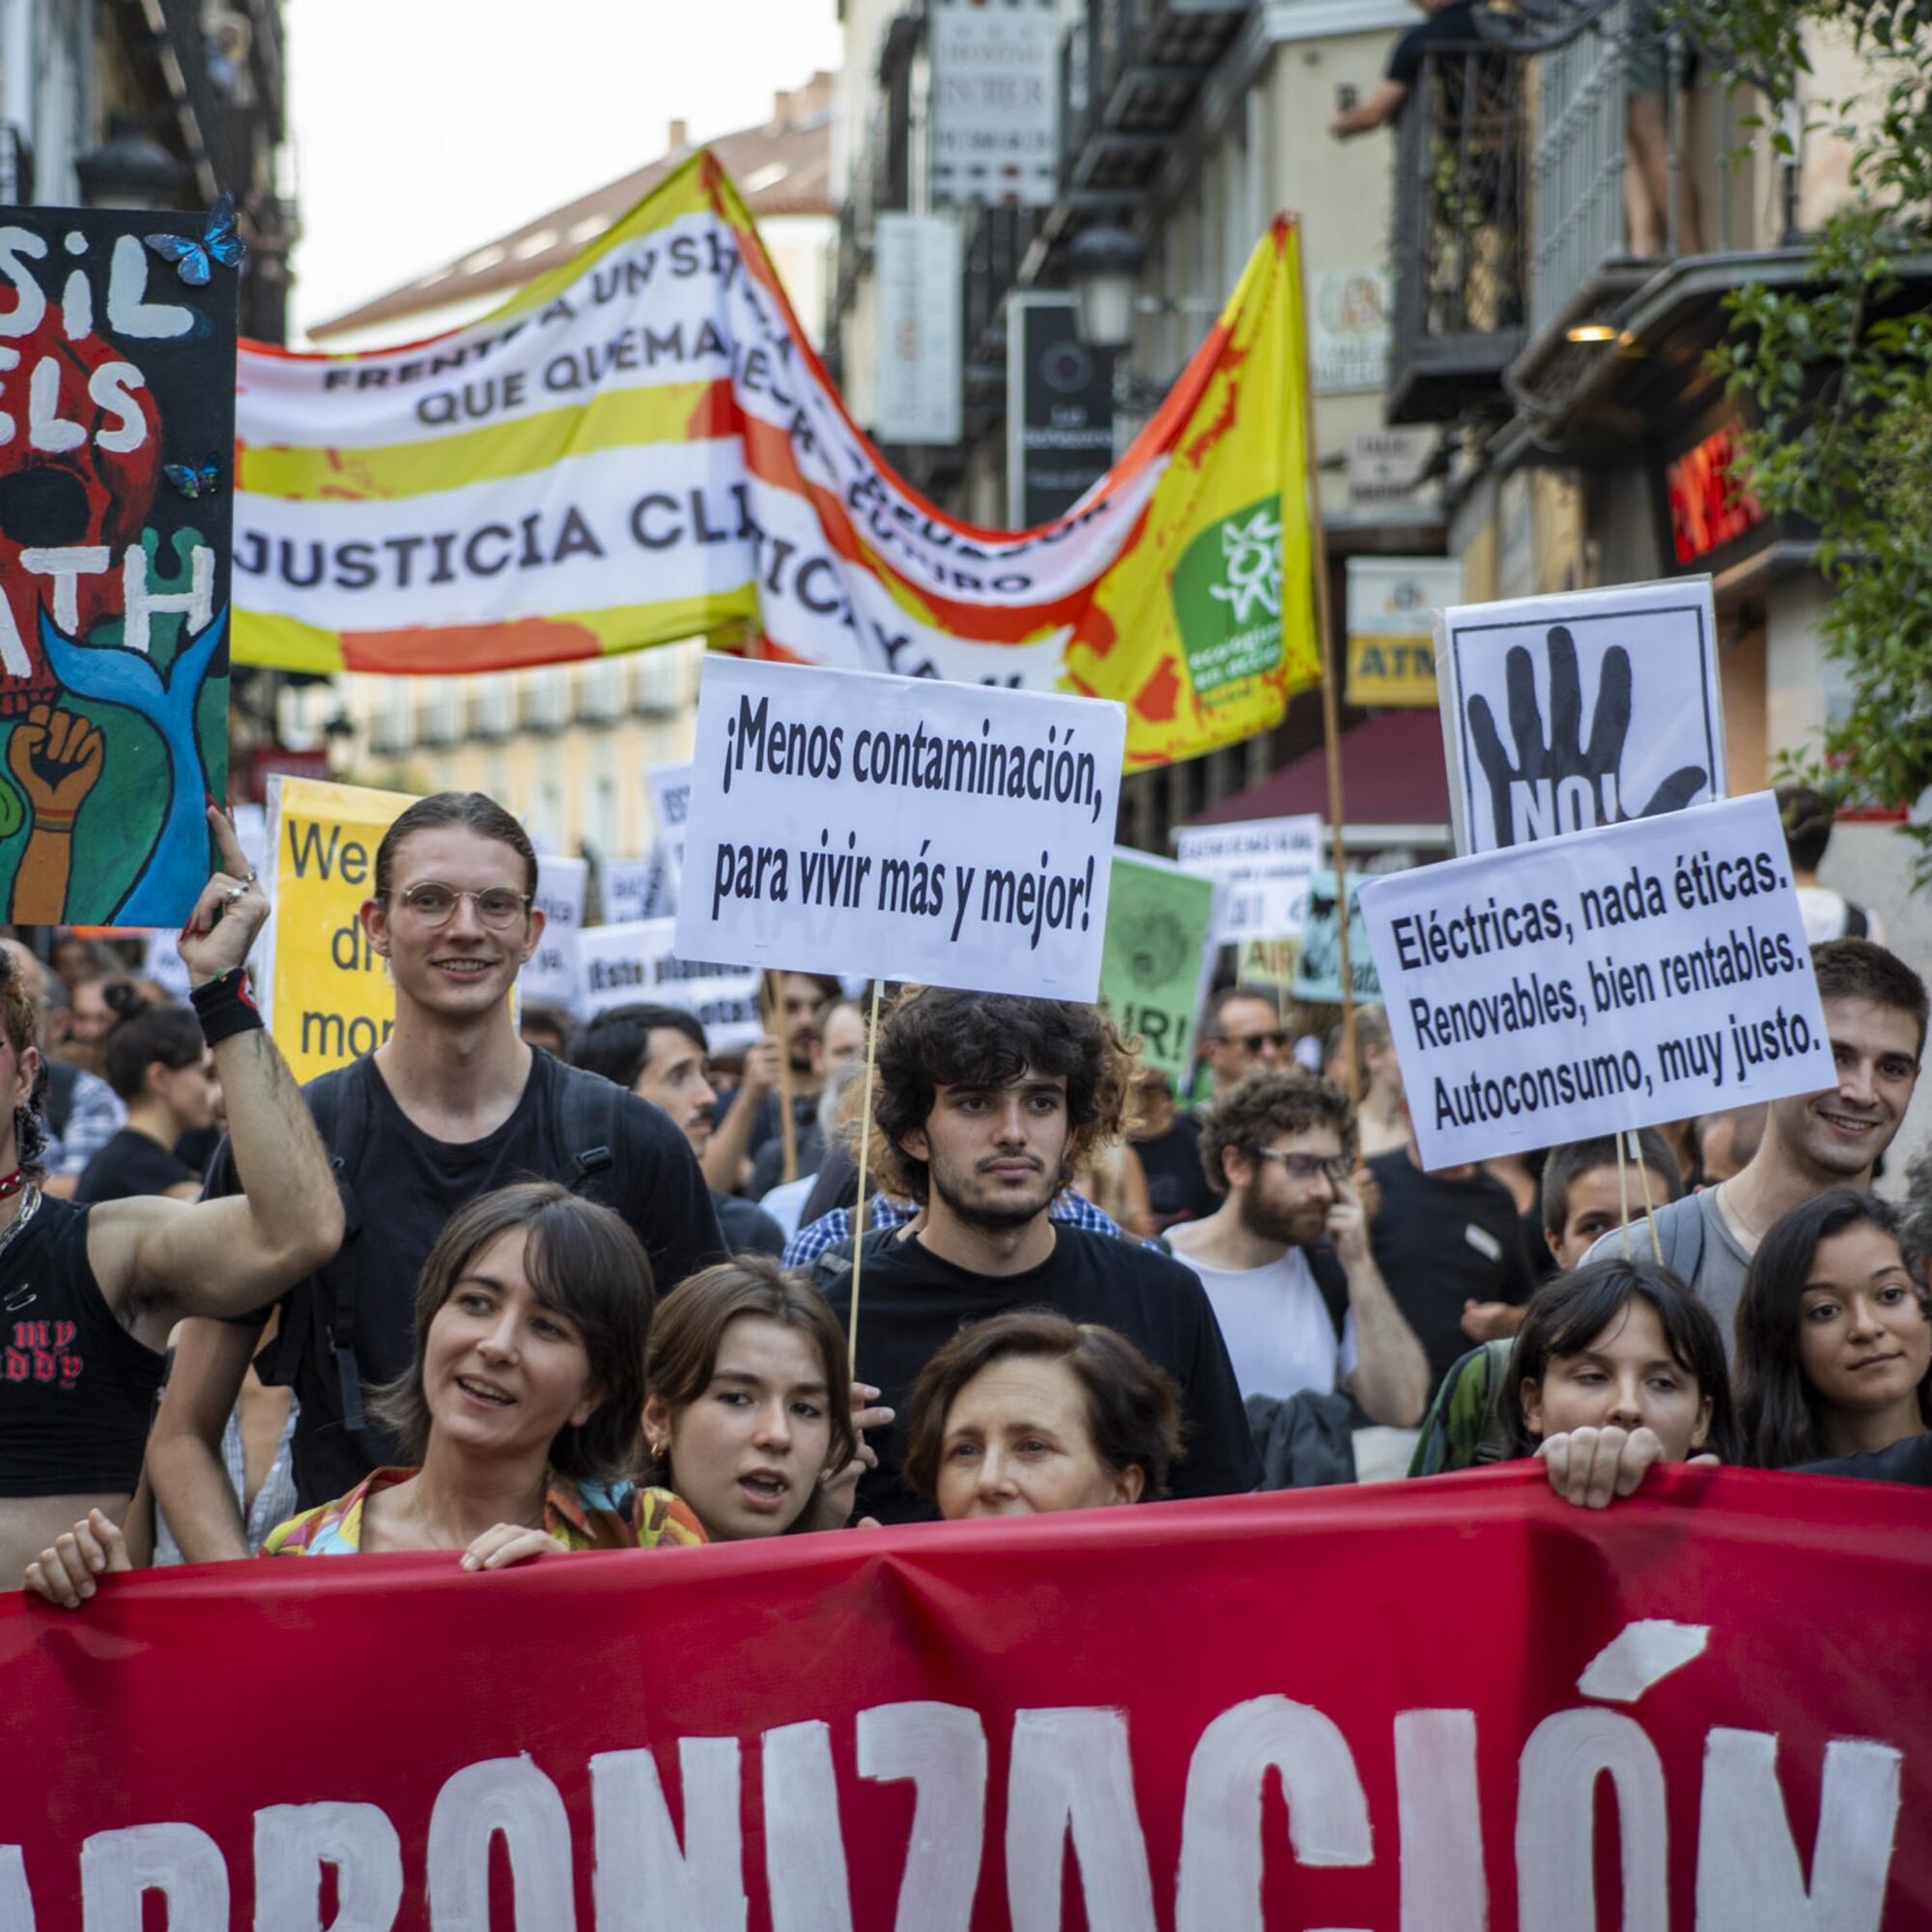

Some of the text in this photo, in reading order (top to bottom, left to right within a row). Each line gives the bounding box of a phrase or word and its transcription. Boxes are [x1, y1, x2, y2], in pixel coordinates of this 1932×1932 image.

[593, 250, 661, 305] UN
[416, 317, 728, 427] QUE QUEMA
[233, 505, 604, 590] JUSTICIA
[723, 695, 1103, 824] ¡Menos contaminación,
[1509, 772, 1617, 844] NO!
[288, 818, 370, 886] We
[711, 828, 1096, 951] para vivir más y mejor!
[1390, 896, 1575, 972] Eléctricas,
[1580, 866, 1667, 931] nada
[1675, 850, 1789, 911] éticas.
[1409, 924, 1805, 1051] Renovables, bien rentables.
[1434, 1004, 1822, 1131] Autoconsumo, muy justo.
[0, 1346, 83, 1389] ddy
[14, 1320, 76, 1356] my
[0, 1619, 1903, 1932] ONIZACIÓN
